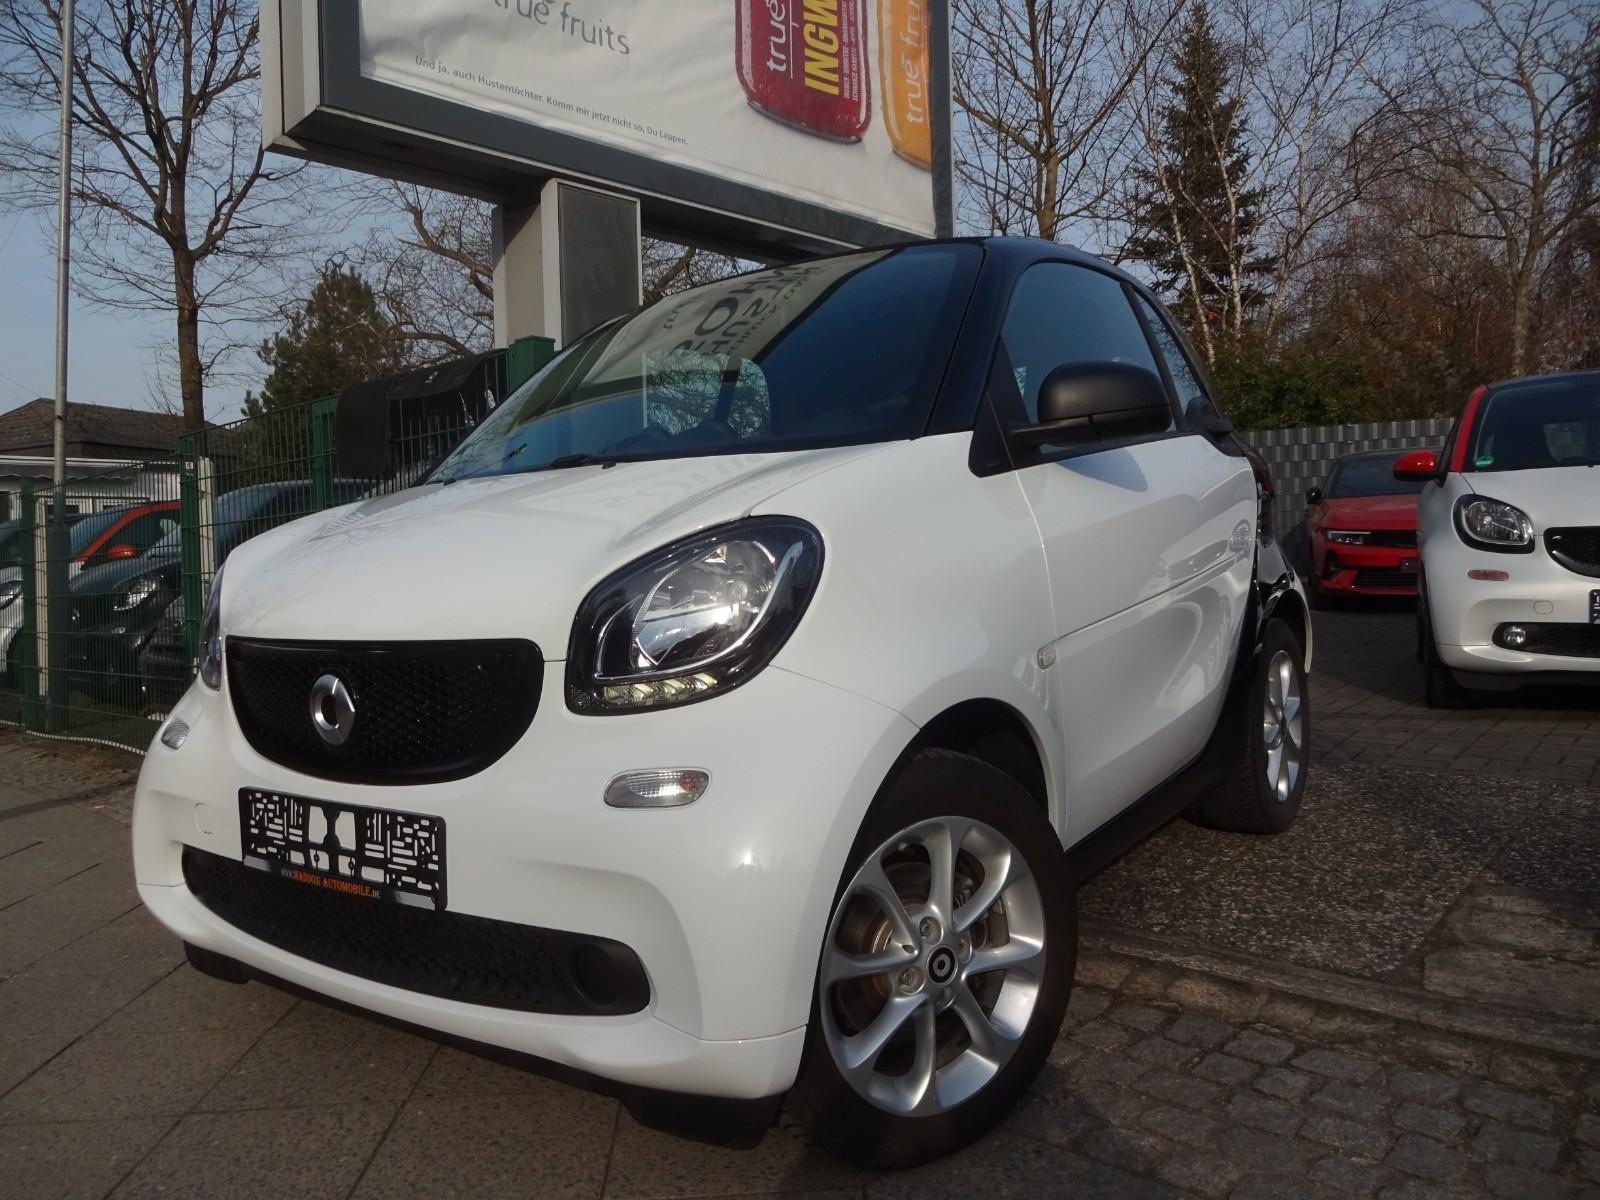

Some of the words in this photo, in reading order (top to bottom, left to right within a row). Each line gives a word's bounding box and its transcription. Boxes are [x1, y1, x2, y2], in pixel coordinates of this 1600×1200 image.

[495, 0, 549, 25] ue
[560, 1, 630, 54] fruits
[415, 55, 435, 70] Und
[438, 61, 450, 75] ja,
[453, 68, 475, 81] auch
[546, 95, 574, 111] Komm
[576, 105, 590, 117] mir
[591, 110, 610, 122] jetzt
[612, 116, 633, 129] nicht
